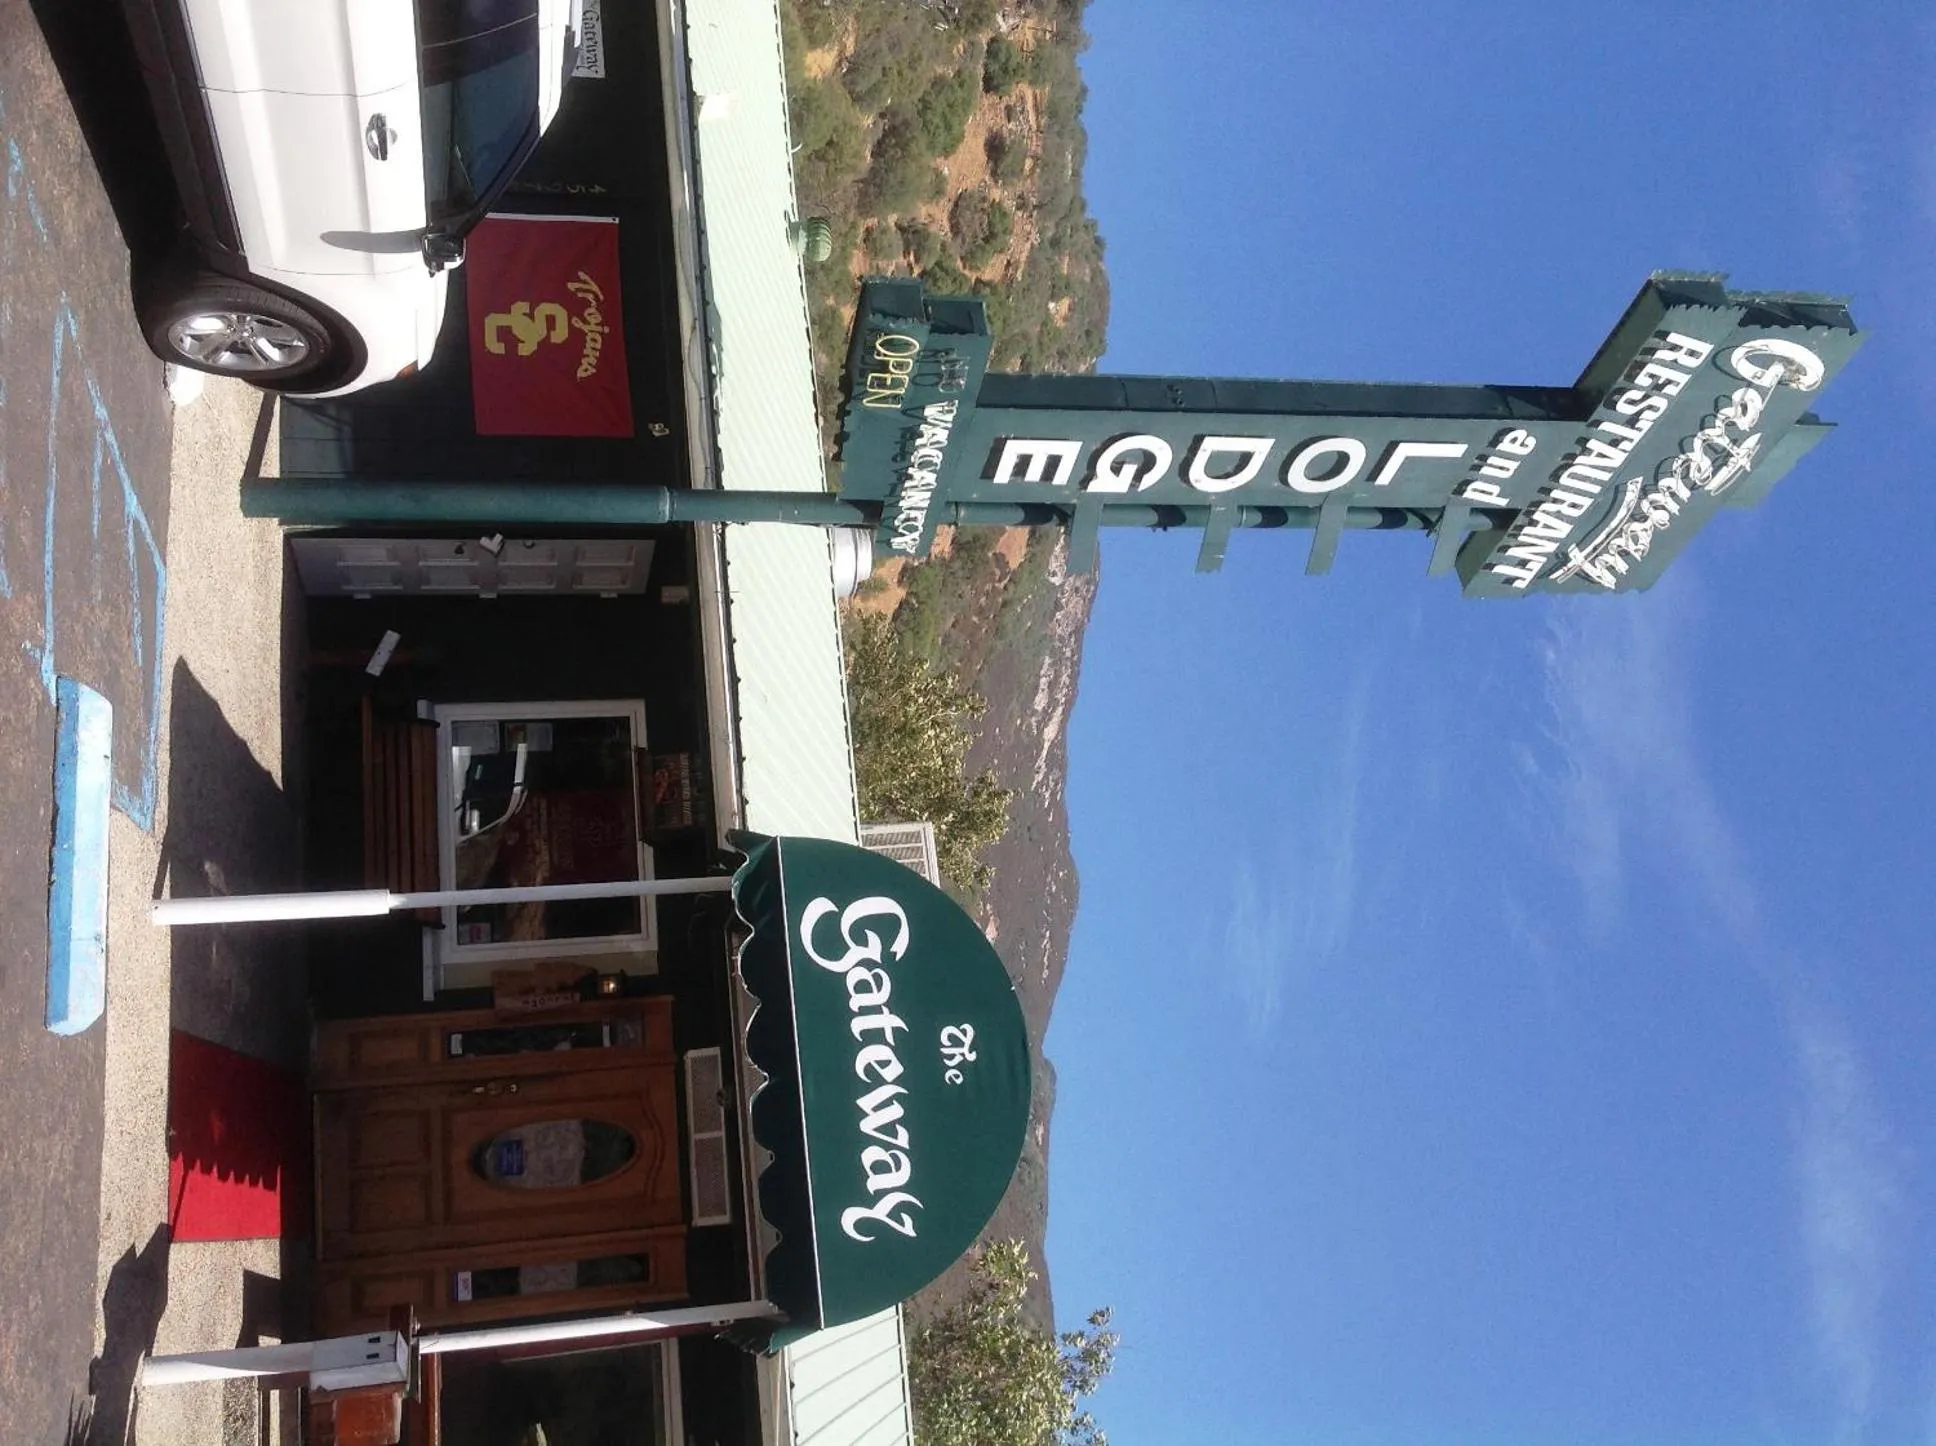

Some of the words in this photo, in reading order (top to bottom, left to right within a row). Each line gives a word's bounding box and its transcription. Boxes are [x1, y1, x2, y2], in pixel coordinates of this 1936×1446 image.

[576, 9, 600, 74] Gateway
[484, 301, 570, 356] SC
[567, 271, 611, 382] Trojans
[861, 334, 921, 409] OPEN
[890, 399, 959, 555] VACANCY
[992, 434, 1469, 494] LODGE
[1461, 429, 1538, 507] and
[1491, 331, 1714, 589] RESTAURANT
[1549, 338, 1826, 590] Gateway
[799, 894, 925, 1242] Gateway
[939, 1022, 978, 1085] The
